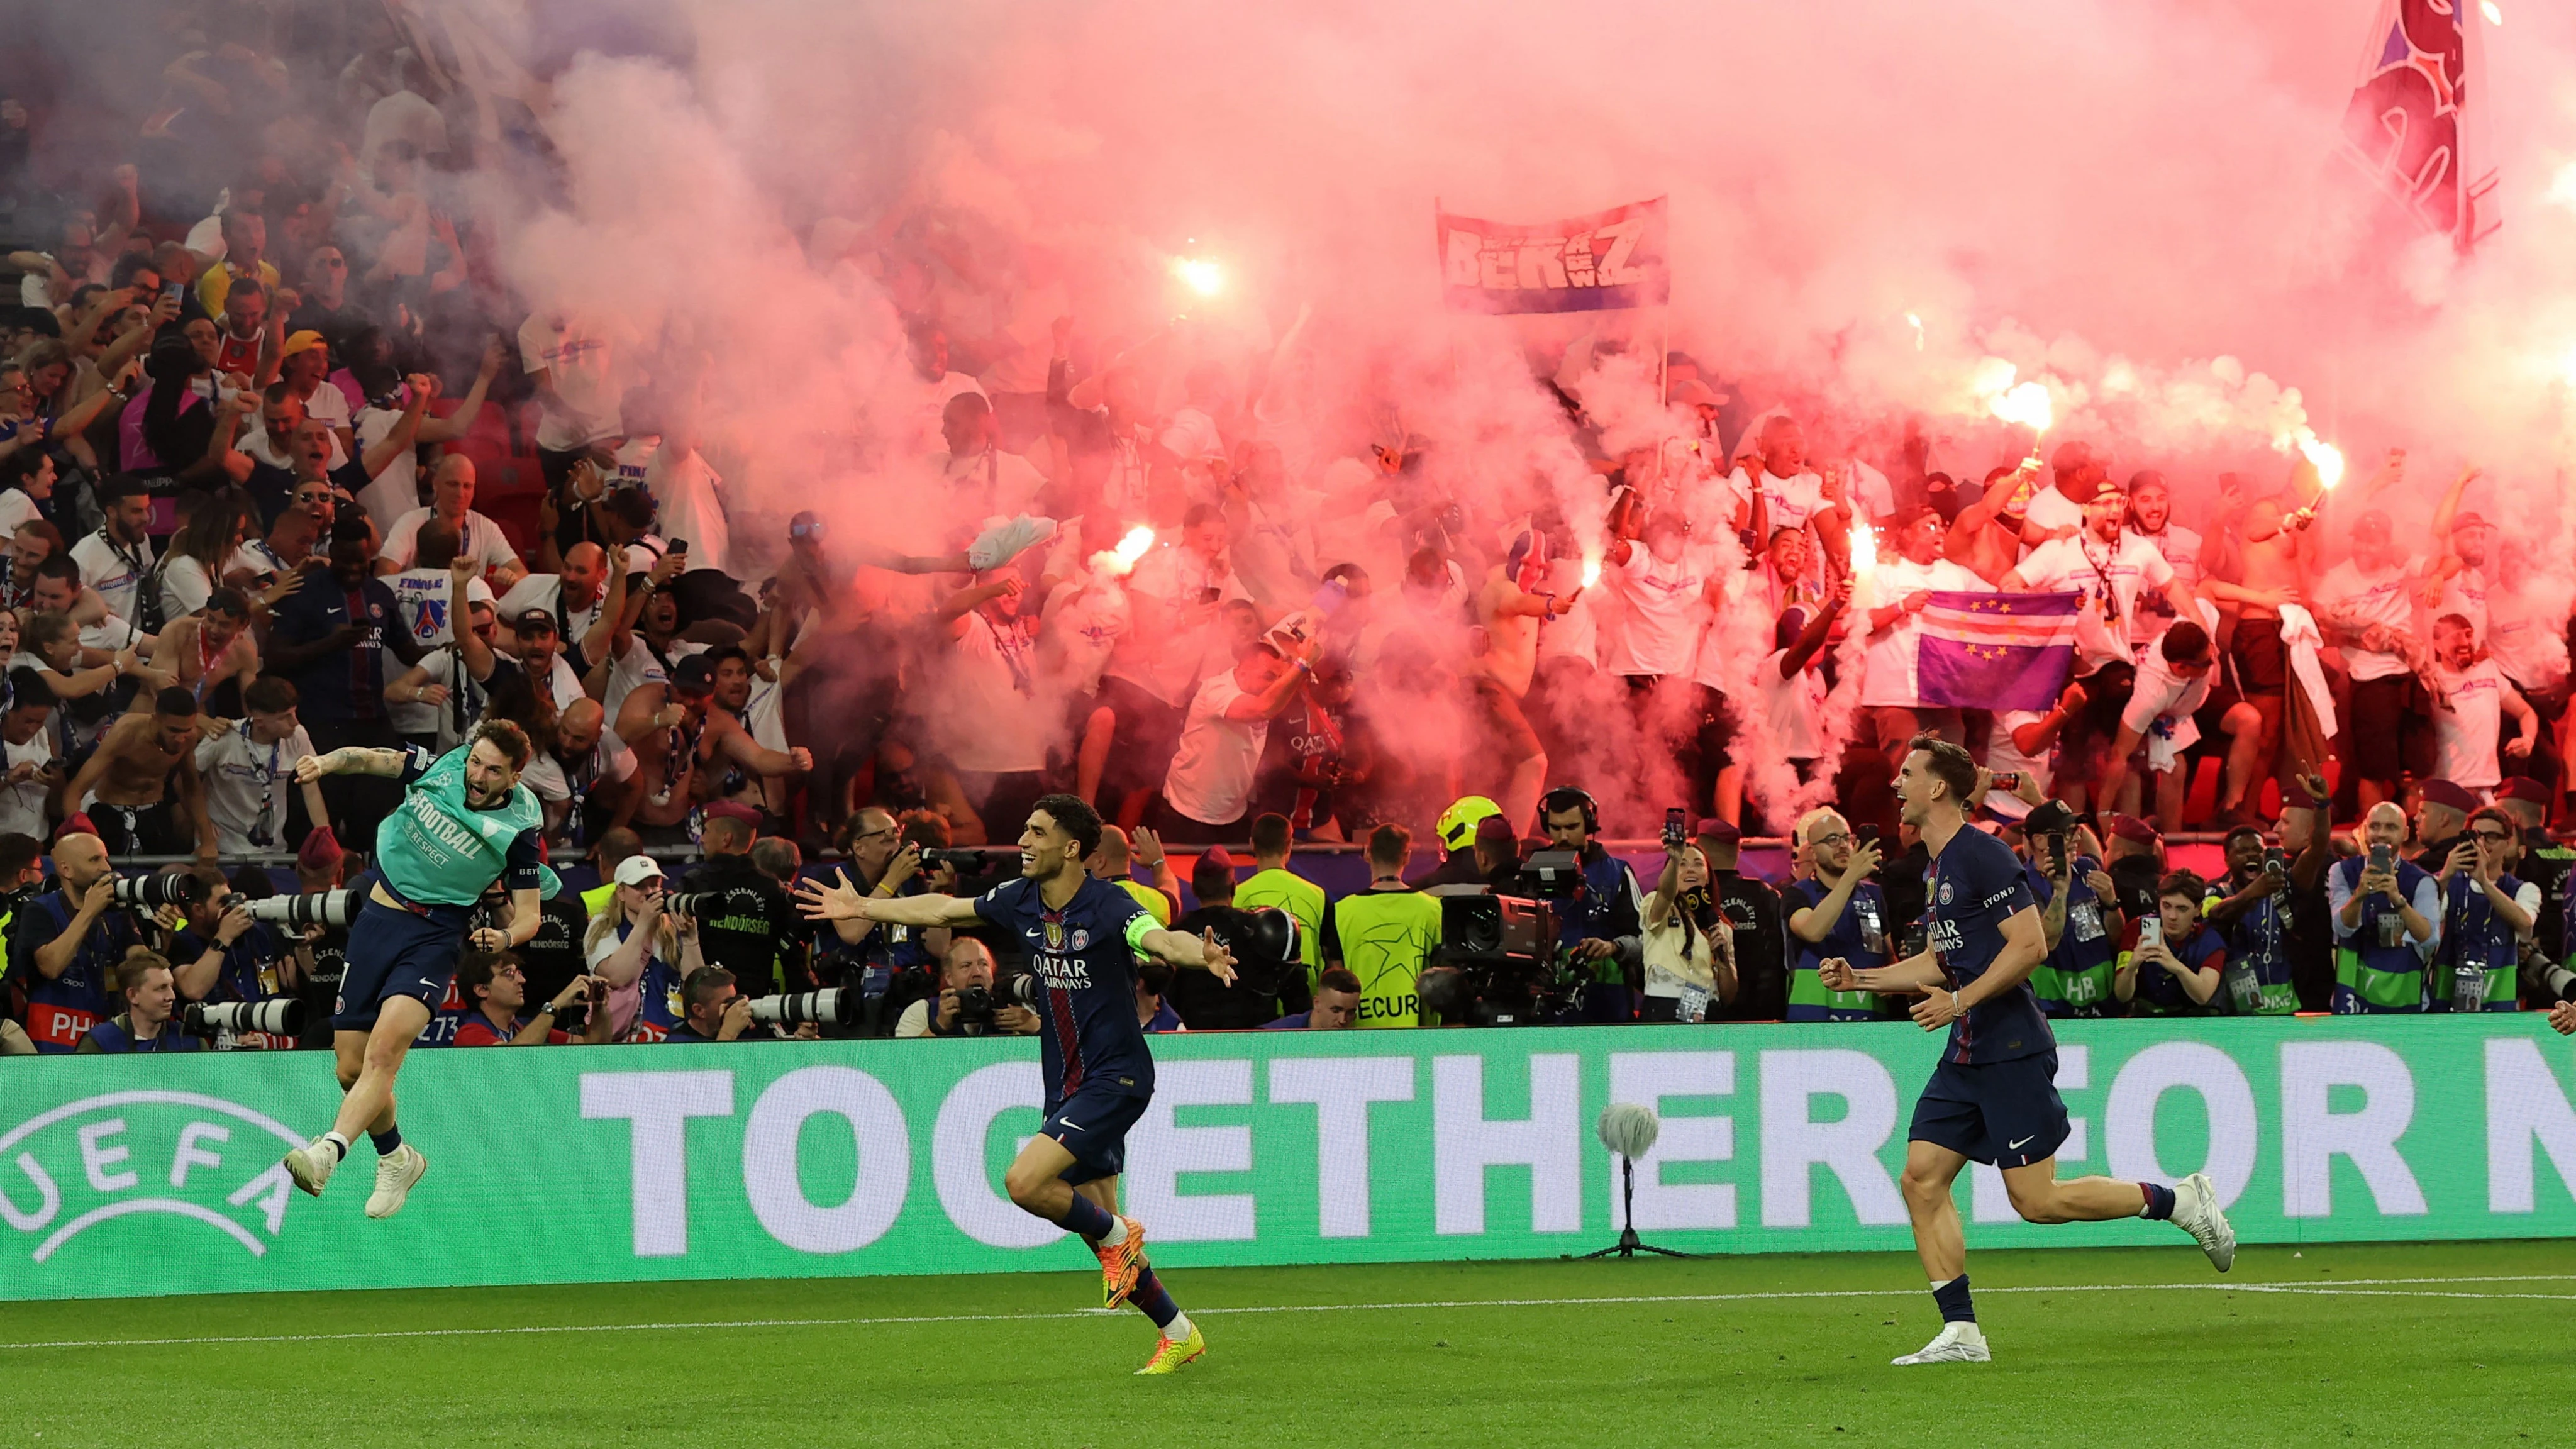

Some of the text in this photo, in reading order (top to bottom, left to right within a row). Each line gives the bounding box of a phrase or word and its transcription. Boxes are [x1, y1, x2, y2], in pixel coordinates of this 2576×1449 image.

[409, 787, 484, 860] #FOOTBALL
[411, 831, 450, 867] RESPECT
[1033, 953, 1089, 978] QATAR
[1044, 976, 1092, 990] AIRWAYS
[1358, 994, 1419, 1019] ECUR
[52, 1012, 94, 1041] PH
[579, 1048, 1931, 1257] TOGETHER
[0, 1118, 296, 1236] UEFA
